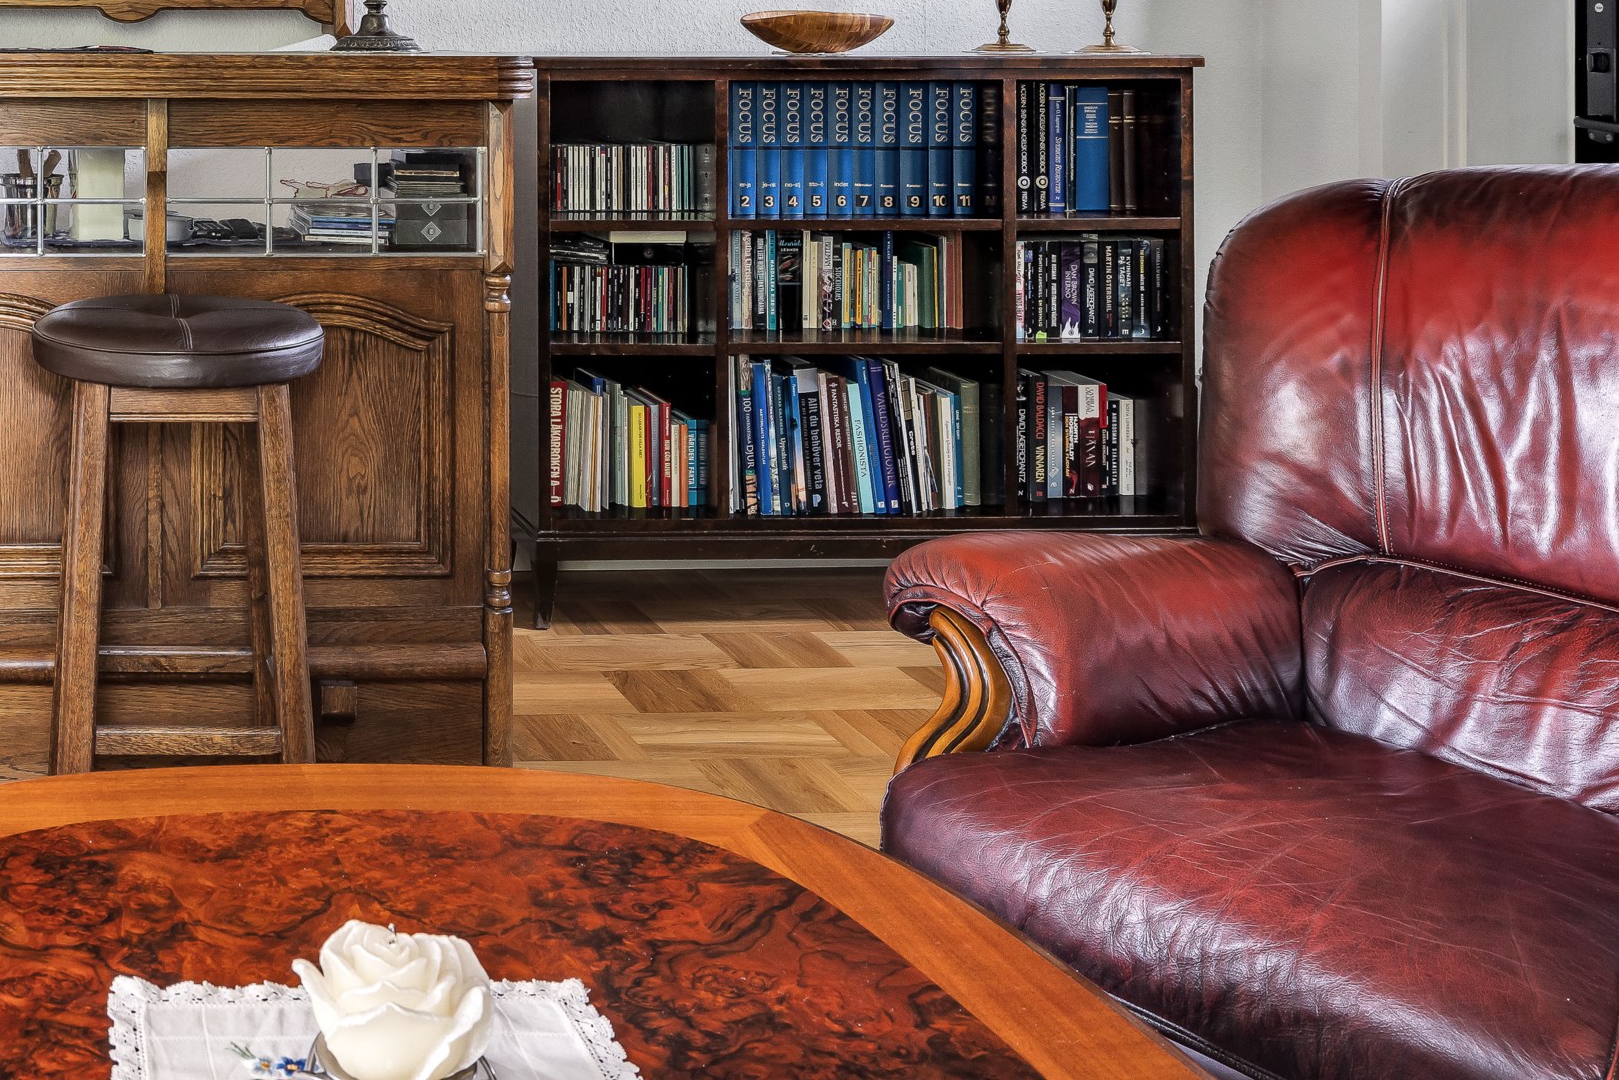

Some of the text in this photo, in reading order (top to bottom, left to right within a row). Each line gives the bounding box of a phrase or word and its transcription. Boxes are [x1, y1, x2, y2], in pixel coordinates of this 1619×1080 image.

[739, 88, 752, 142] FOCUS
[763, 88, 776, 142] FOCUS
[787, 88, 800, 142] FOCUS
[810, 88, 823, 142] FOCUS
[835, 88, 849, 142] FOCUS
[858, 88, 871, 142] FOCUS
[882, 88, 896, 142] FOCUS
[908, 88, 922, 142] FOCUS
[935, 88, 949, 142] FOCUS
[959, 88, 973, 142] FOCUS
[741, 195, 750, 207] 2
[765, 195, 774, 207] 3
[788, 195, 798, 207] 4
[812, 195, 821, 207] 5
[837, 195, 846, 207] 6
[860, 195, 869, 207] 7
[884, 195, 893, 207] 8
[910, 195, 920, 207] 9
[933, 195, 947, 207] 10
[959, 195, 971, 207] 11
[742, 232, 752, 287] Agatha Christie
[1119, 255, 1126, 264] PÅ
[834, 266, 842, 301] STOCKHOLMS
[551, 387, 563, 416] STORA
[742, 396, 752, 412] 100
[831, 388, 840, 428] FANTASTISKA
[1036, 382, 1044, 440] DAVID BALDACCI
[688, 434, 696, 461] VÄRLDEN
[744, 444, 755, 469] DJUR
[807, 397, 823, 490] Allt du behöver veta
[854, 419, 867, 478] FASHIONISTA
[876, 391, 895, 488] VÄRLDSRELIGIONER
[1018, 409, 1026, 483] DAVID LAGERCRANTZ
[1085, 430, 1096, 468] HÄXAN
[1036, 445, 1044, 483] VINNAREN
